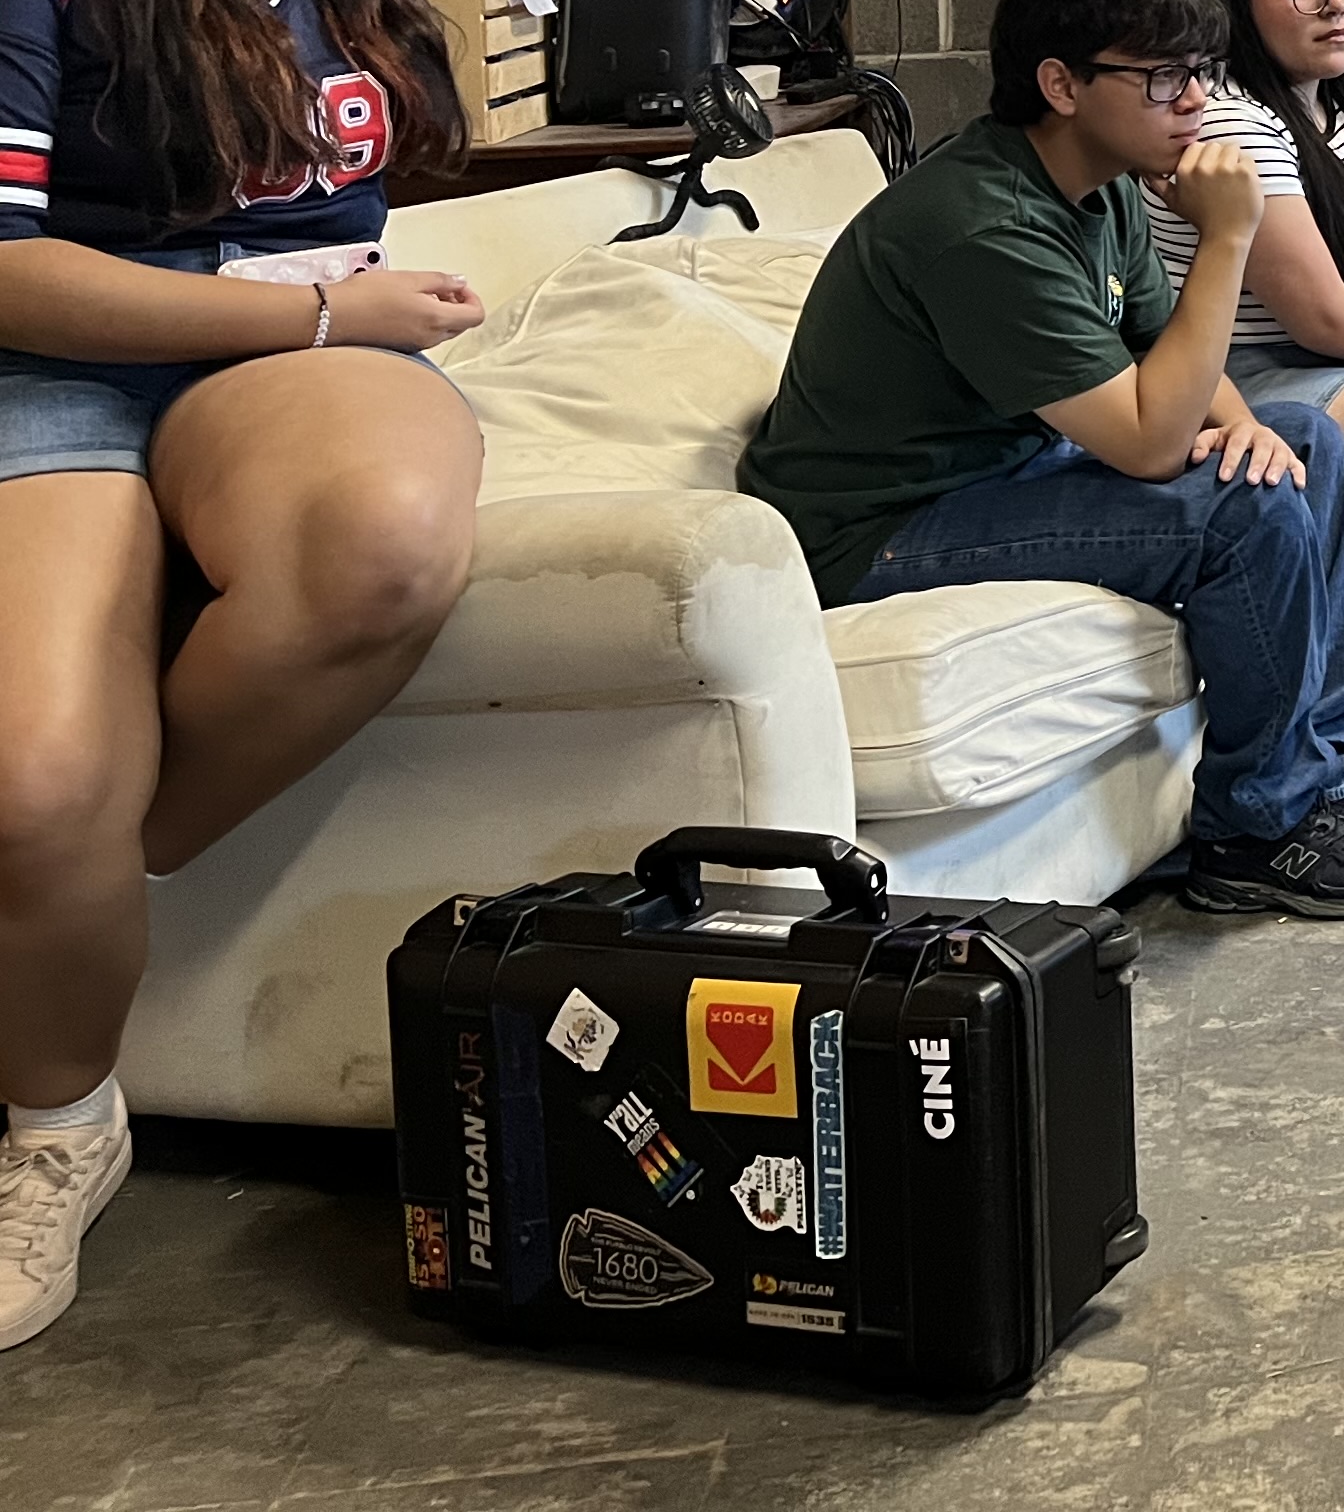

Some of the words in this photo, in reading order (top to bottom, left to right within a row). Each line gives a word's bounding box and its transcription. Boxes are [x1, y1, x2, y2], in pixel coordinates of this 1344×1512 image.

[710, 1011, 769, 1025] KODAK
[908, 1038, 955, 1139] CINÉ
[627, 1118, 660, 1156] means
[464, 1113, 493, 1270] PELICAN
[593, 1247, 658, 1283] 1680
[779, 1279, 834, 1297] PELICAN
